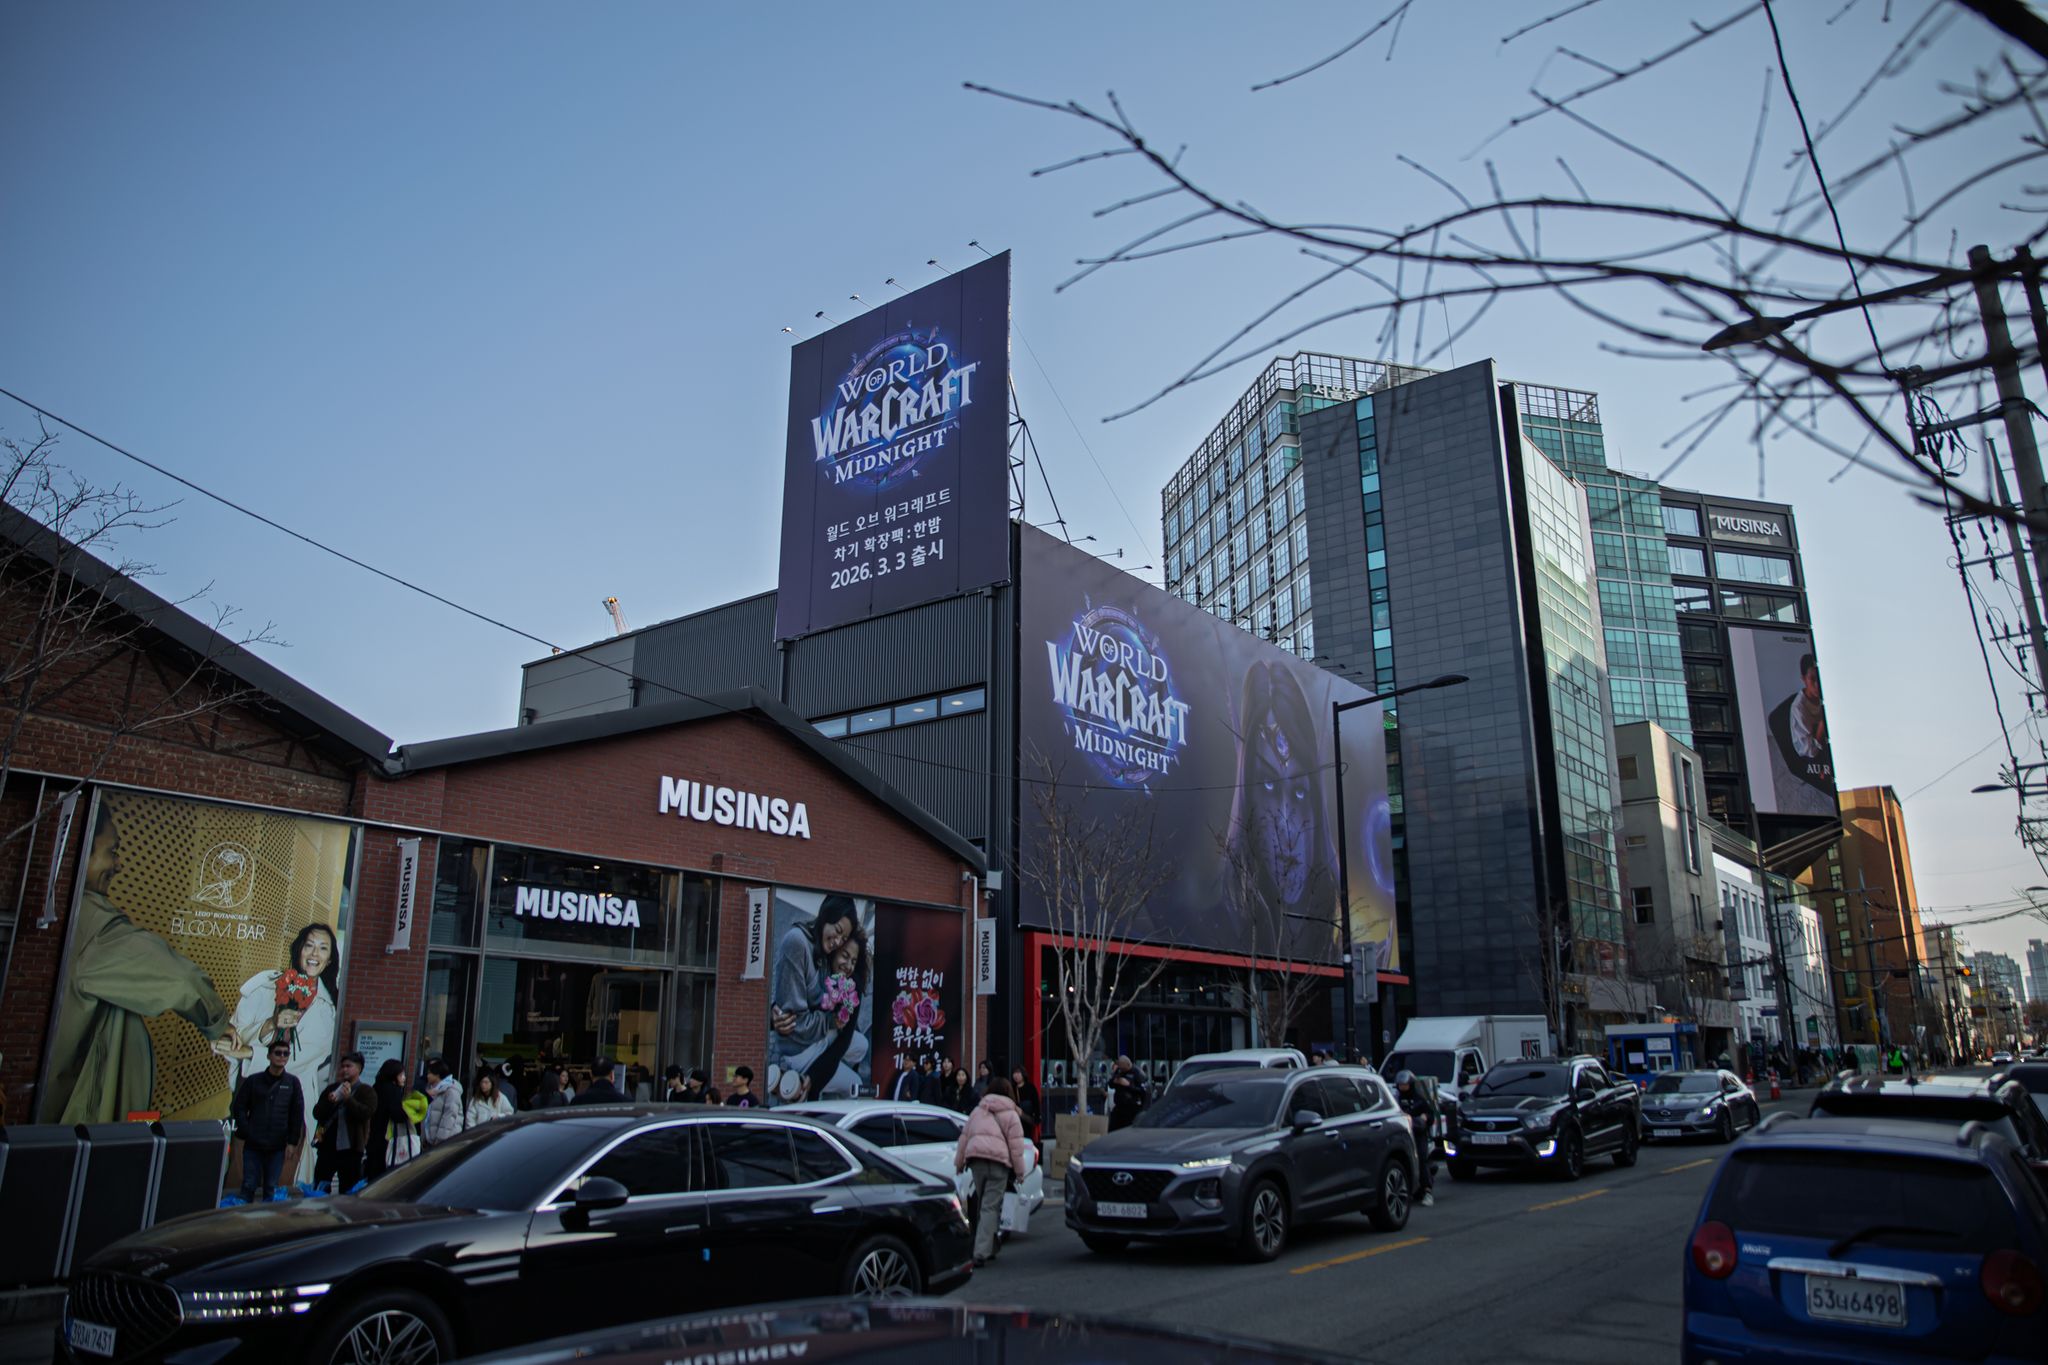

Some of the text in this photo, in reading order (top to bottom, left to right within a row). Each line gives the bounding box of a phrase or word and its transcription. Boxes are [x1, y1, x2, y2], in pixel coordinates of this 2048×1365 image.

[839, 343, 948, 402] WORLD
[870, 375, 882, 386] OF
[811, 362, 977, 461] WARCRAFT
[835, 428, 947, 484] MIDNIGHT
[827, 488, 951, 542] 월드 오브 워크래프트
[1717, 516, 1782, 536] MUSINSA
[830, 539, 944, 589] 2026. 3. 3 출시
[834, 541, 859, 562] 차기
[1072, 621, 1168, 682] WORLD
[1103, 642, 1114, 656] OF
[1046, 640, 1189, 745] WARCRAFT
[1074, 725, 1170, 774] MIDNIGHT
[659, 775, 811, 840] MUSINSA
[397, 857, 413, 932] MUSINSA
[515, 885, 640, 929] MUSINSA
[171, 917, 266, 941] BLOOM BAR
[751, 903, 762, 964] MUSINSA
[896, 966, 944, 989] 변함 없이
[981, 931, 990, 982] MUSINSA
